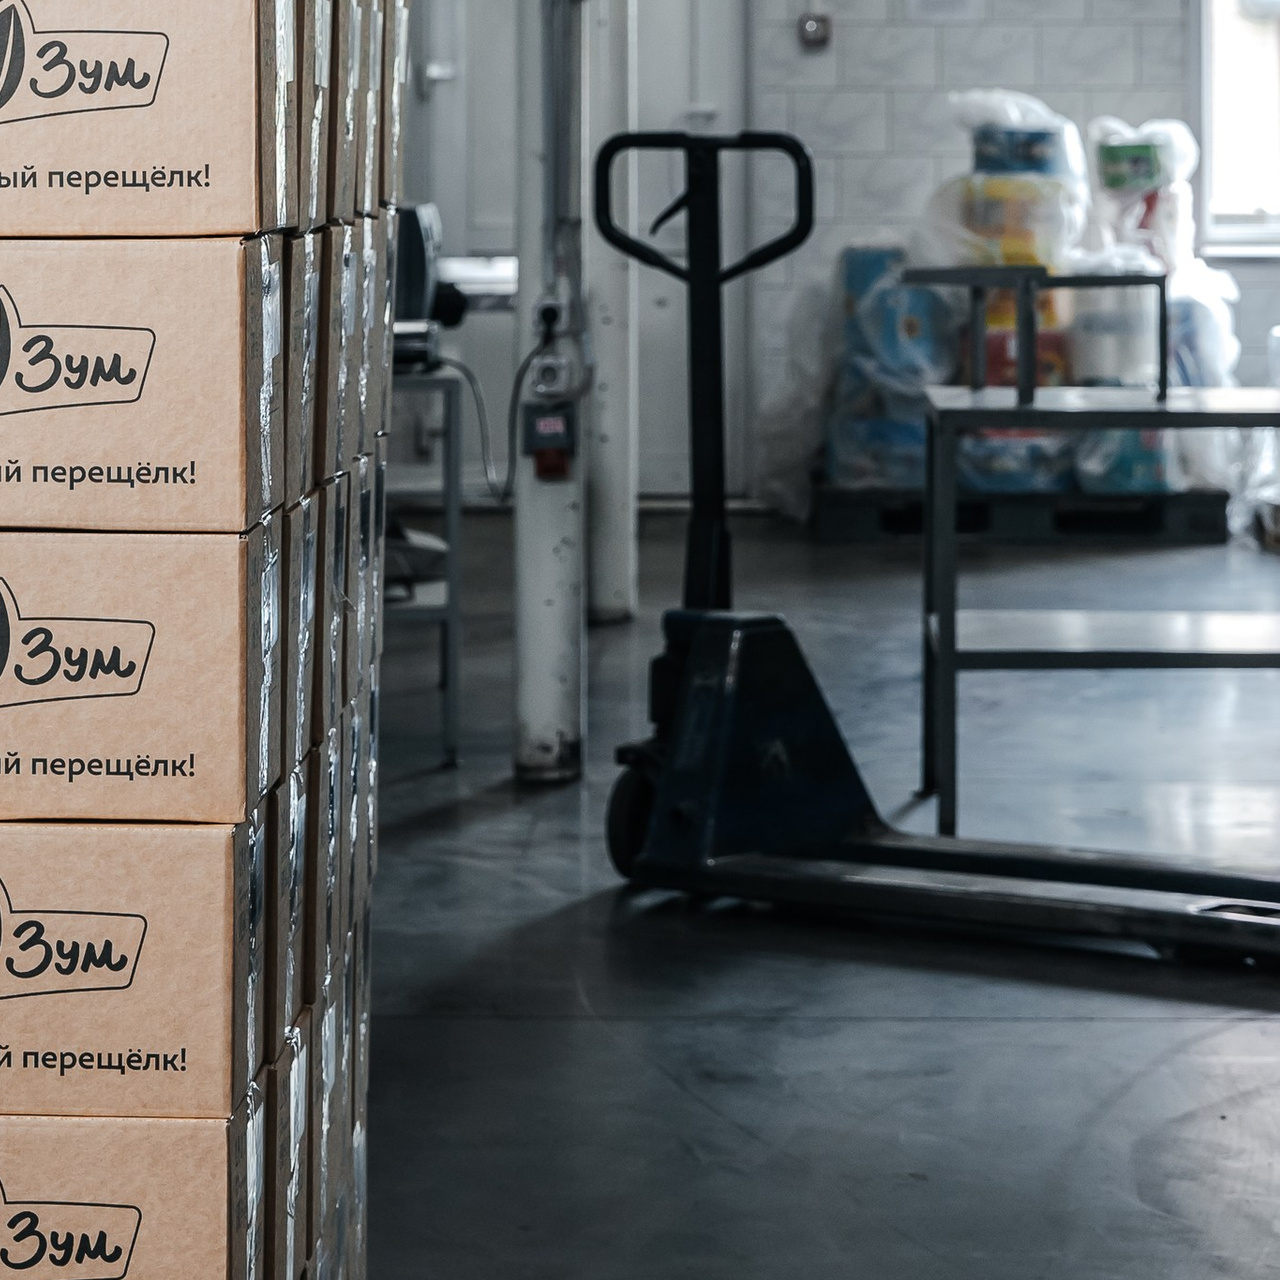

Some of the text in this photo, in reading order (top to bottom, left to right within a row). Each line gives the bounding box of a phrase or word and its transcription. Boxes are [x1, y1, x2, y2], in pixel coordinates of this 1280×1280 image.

[29, 40, 151, 99] Зум
[48, 163, 211, 196] перещёлк!
[14, 334, 137, 394] Зум
[32, 460, 196, 491] перещёлк!
[13, 626, 137, 686] Зум
[31, 753, 195, 783] перещёлк!
[5, 919, 129, 979] Зум
[22, 1047, 187, 1077] перещёлк!
[0, 1210, 123, 1270] Зум
